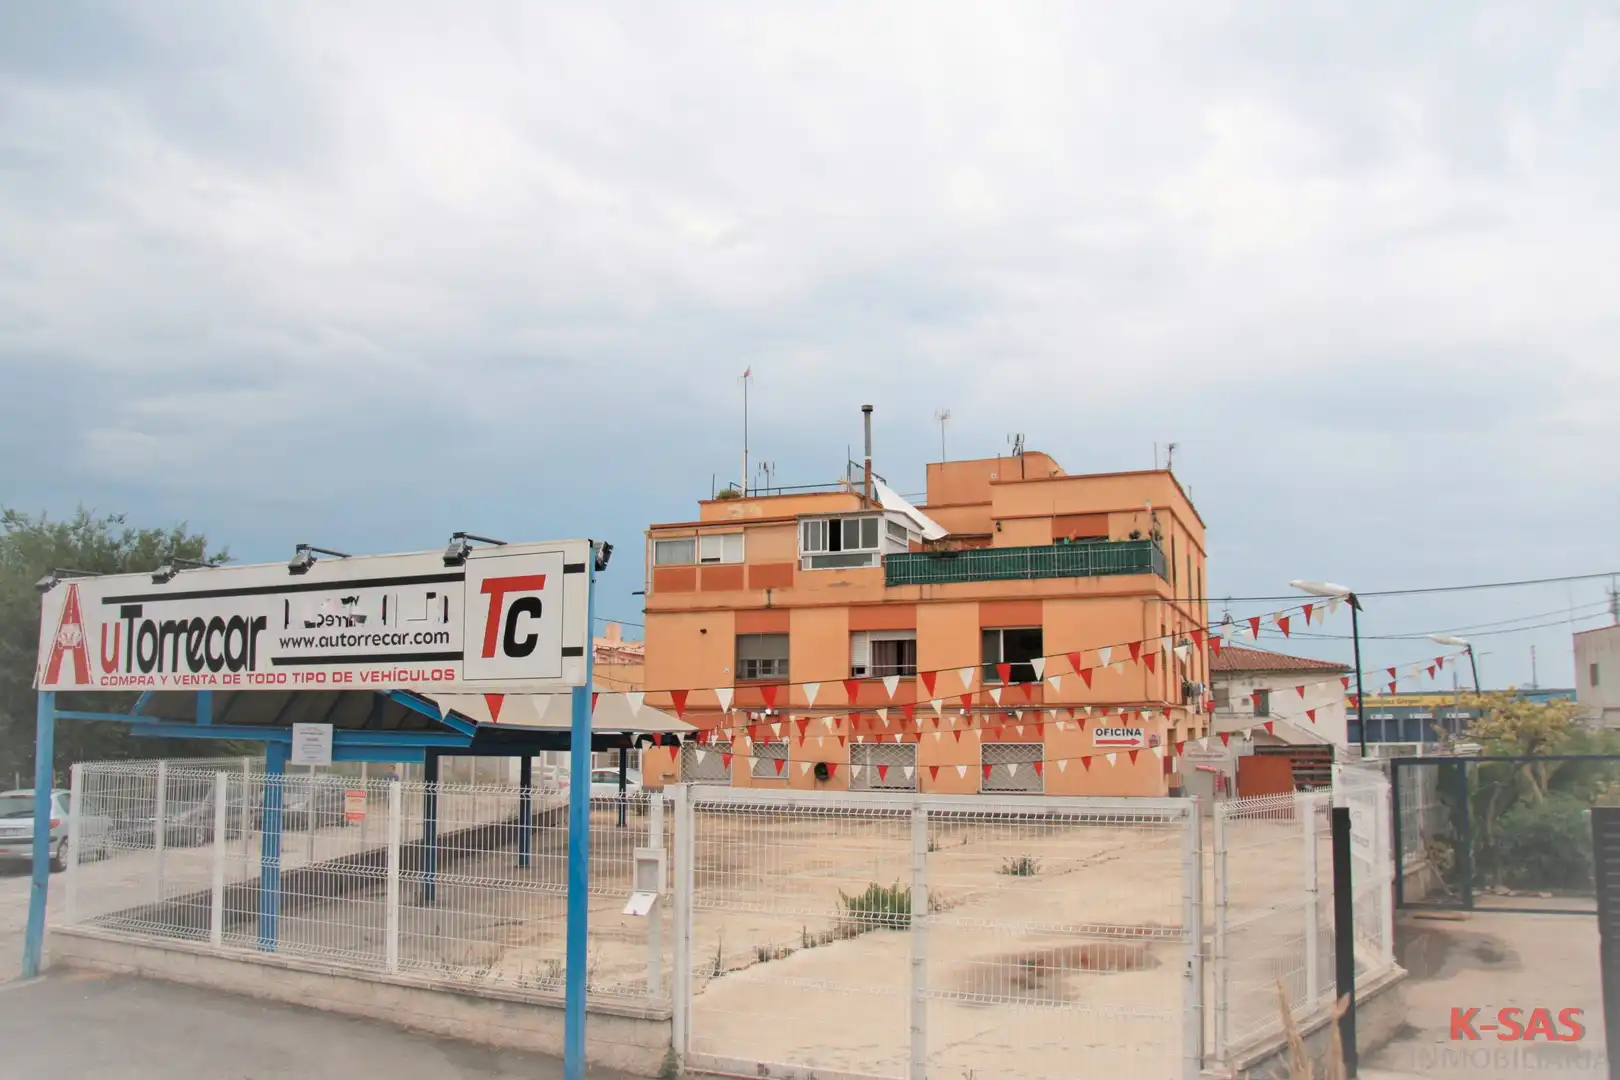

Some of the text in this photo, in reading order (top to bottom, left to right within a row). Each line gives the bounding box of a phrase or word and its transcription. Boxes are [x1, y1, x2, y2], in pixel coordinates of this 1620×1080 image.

[279, 630, 450, 649] www.autorrecar.com
[100, 667, 456, 686] COMPRA Y VENTA DE TODO TIPO DE VEHÍCULOS
[1095, 728, 1142, 737] OFICINA
